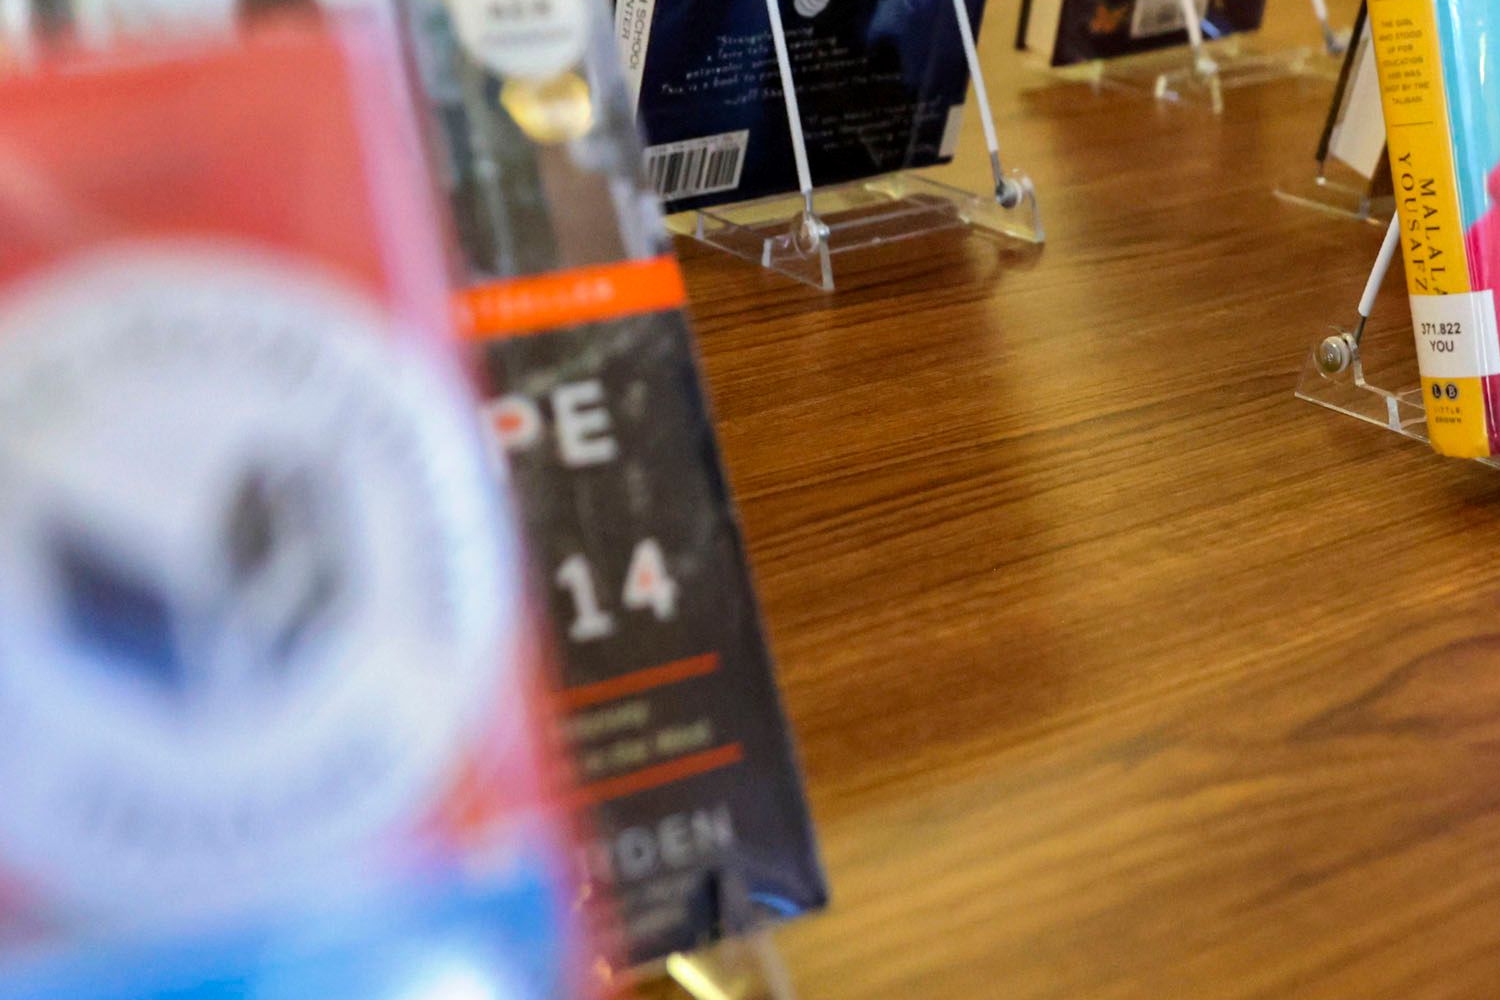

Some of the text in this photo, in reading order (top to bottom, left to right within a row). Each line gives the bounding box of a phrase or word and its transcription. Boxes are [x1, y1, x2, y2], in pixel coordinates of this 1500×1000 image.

[1421, 322, 1461, 335] 371.822
[1430, 340, 1454, 352] YOU
[556, 537, 678, 641] 14
